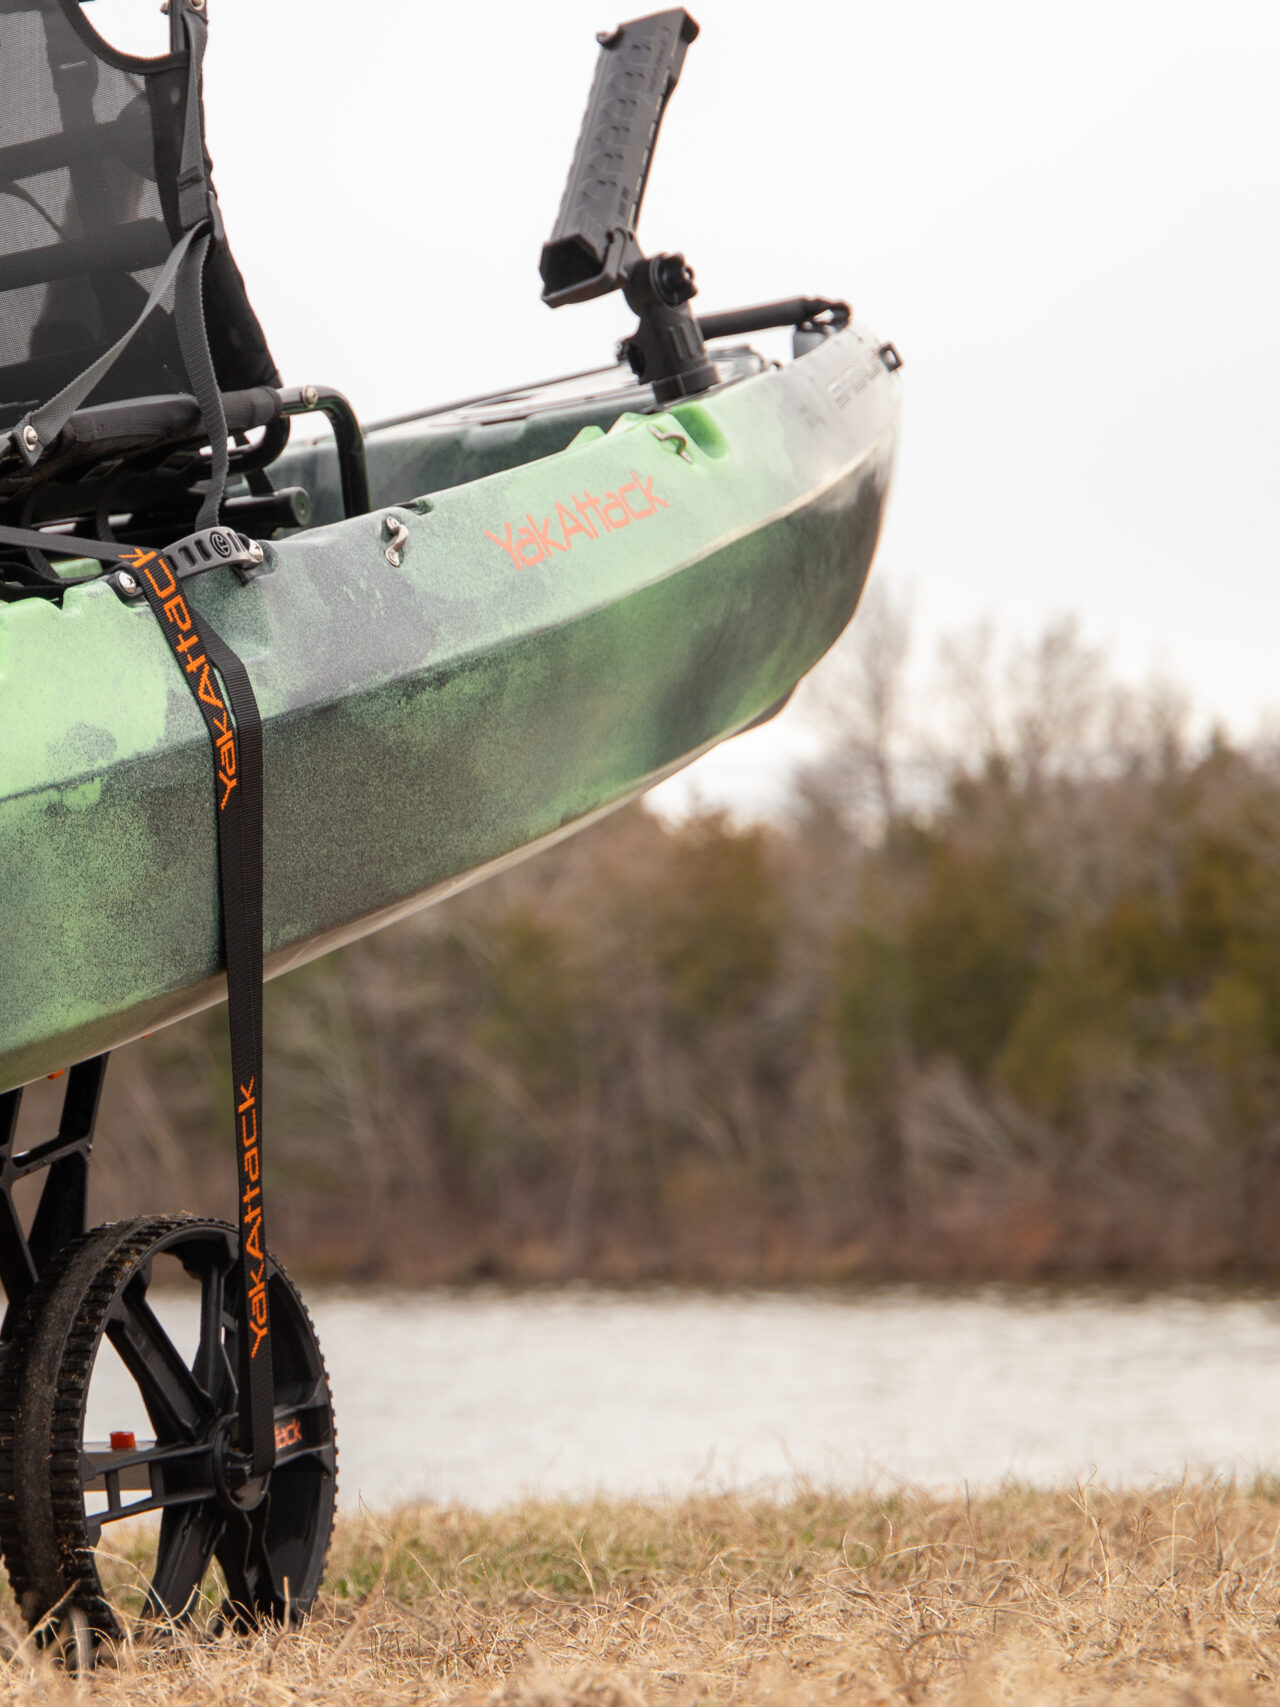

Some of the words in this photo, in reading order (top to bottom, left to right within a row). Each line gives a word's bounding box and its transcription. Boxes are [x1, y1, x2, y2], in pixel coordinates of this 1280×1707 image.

[484, 471, 670, 571] YakAttack
[119, 548, 238, 810] YakAttack
[238, 1075, 269, 1360] YakAttack
